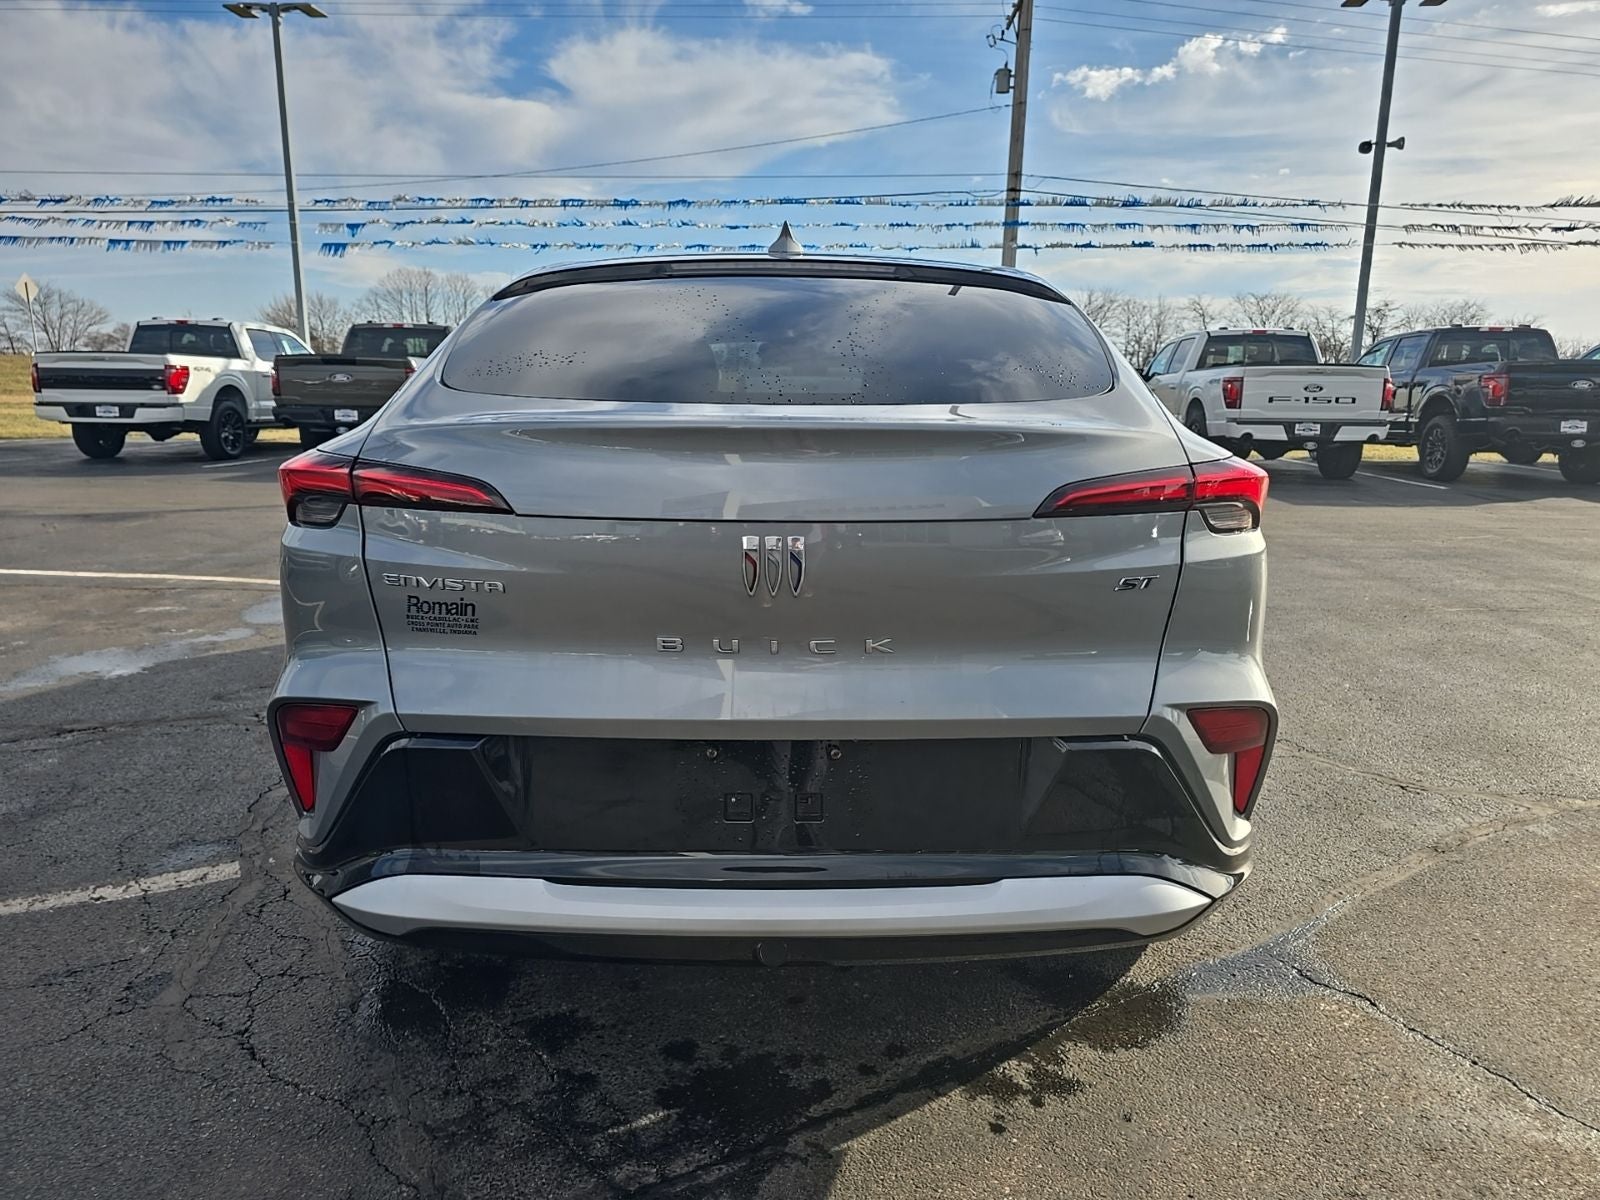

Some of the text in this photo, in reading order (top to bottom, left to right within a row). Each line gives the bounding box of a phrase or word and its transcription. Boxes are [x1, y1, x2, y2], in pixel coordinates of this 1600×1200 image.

[1268, 396, 1356, 404] F-150
[382, 573, 506, 593] ENVISTA
[1113, 575, 1160, 591] ST
[407, 595, 476, 616] Romain
[656, 637, 895, 654] BUICK
